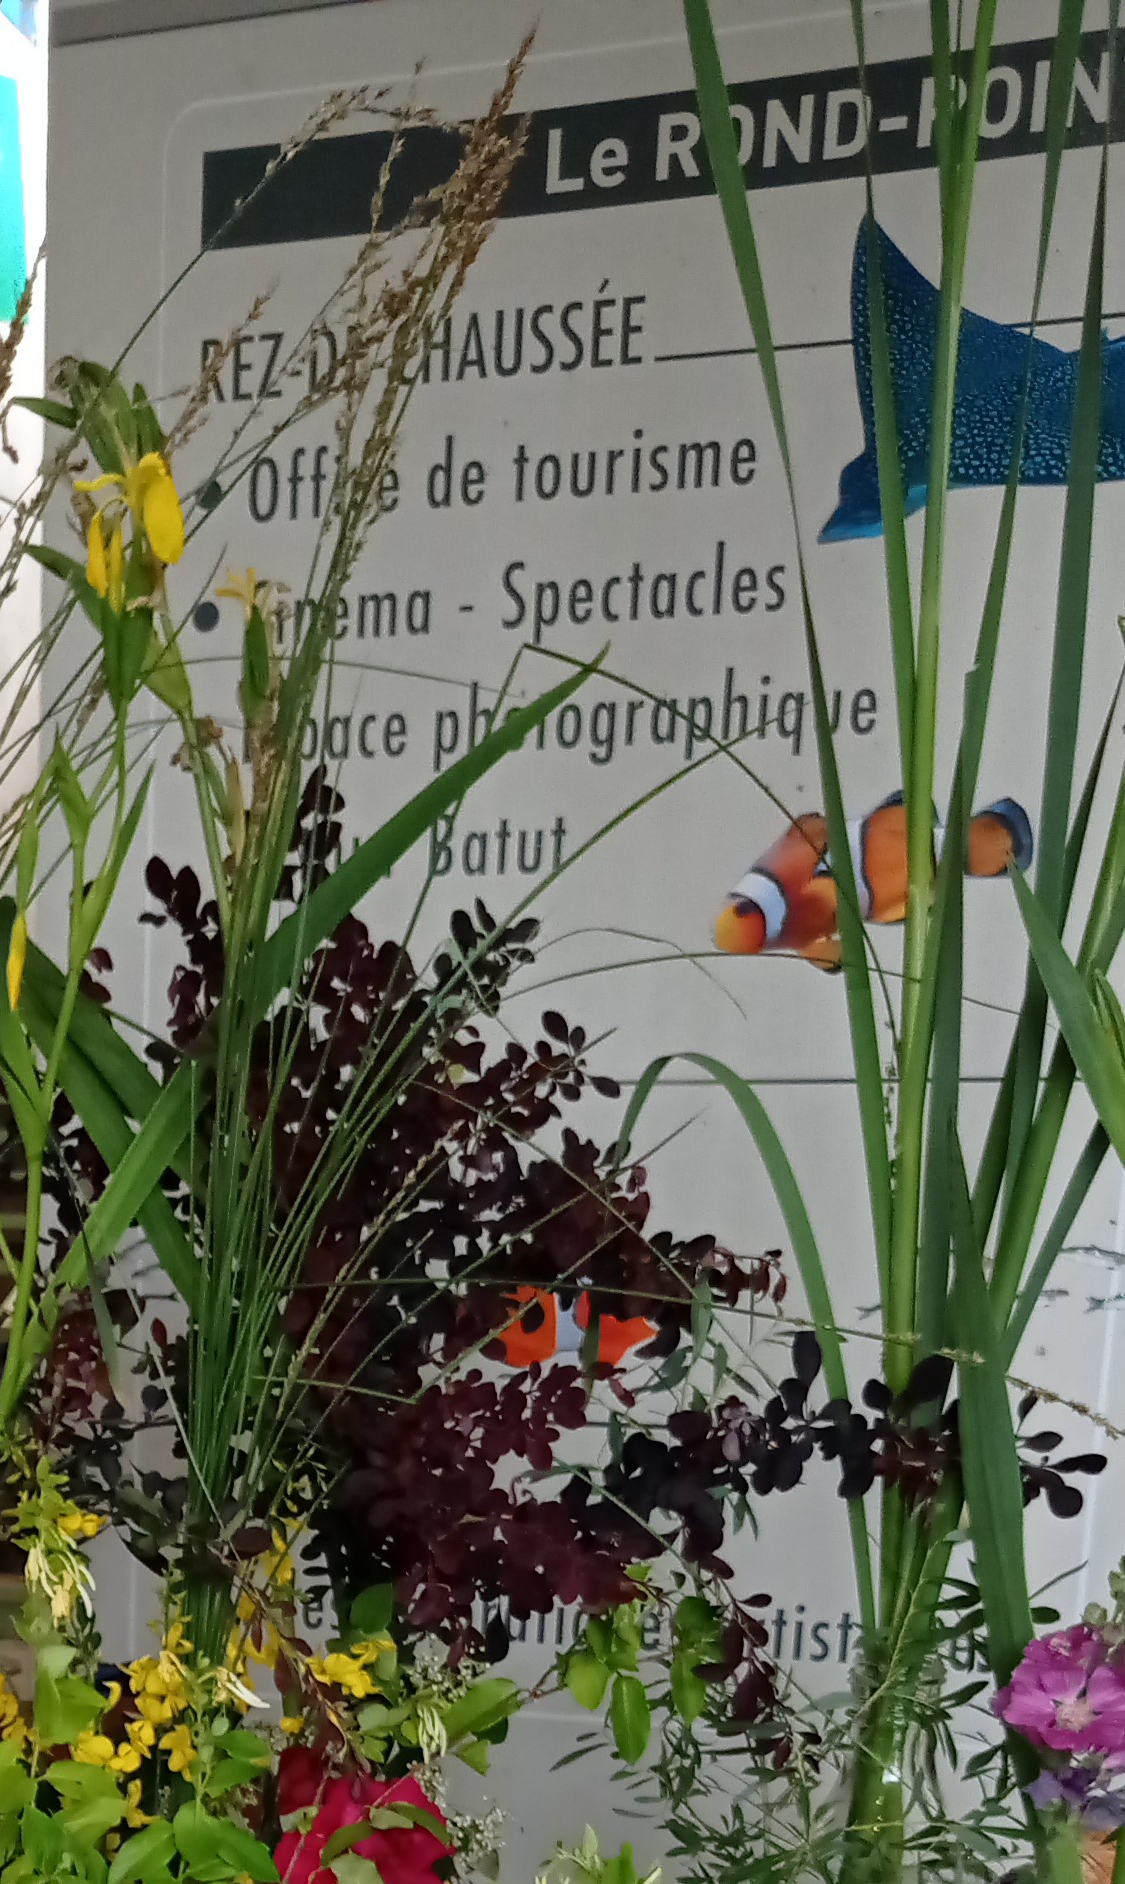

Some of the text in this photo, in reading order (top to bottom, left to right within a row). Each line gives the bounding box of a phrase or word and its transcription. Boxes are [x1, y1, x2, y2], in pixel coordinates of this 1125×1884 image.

[544, 128, 627, 195] Le
[249, 427, 757, 523] Offe de tourisme
[501, 540, 788, 648] Spectacles
[432, 813, 569, 877] Batut
